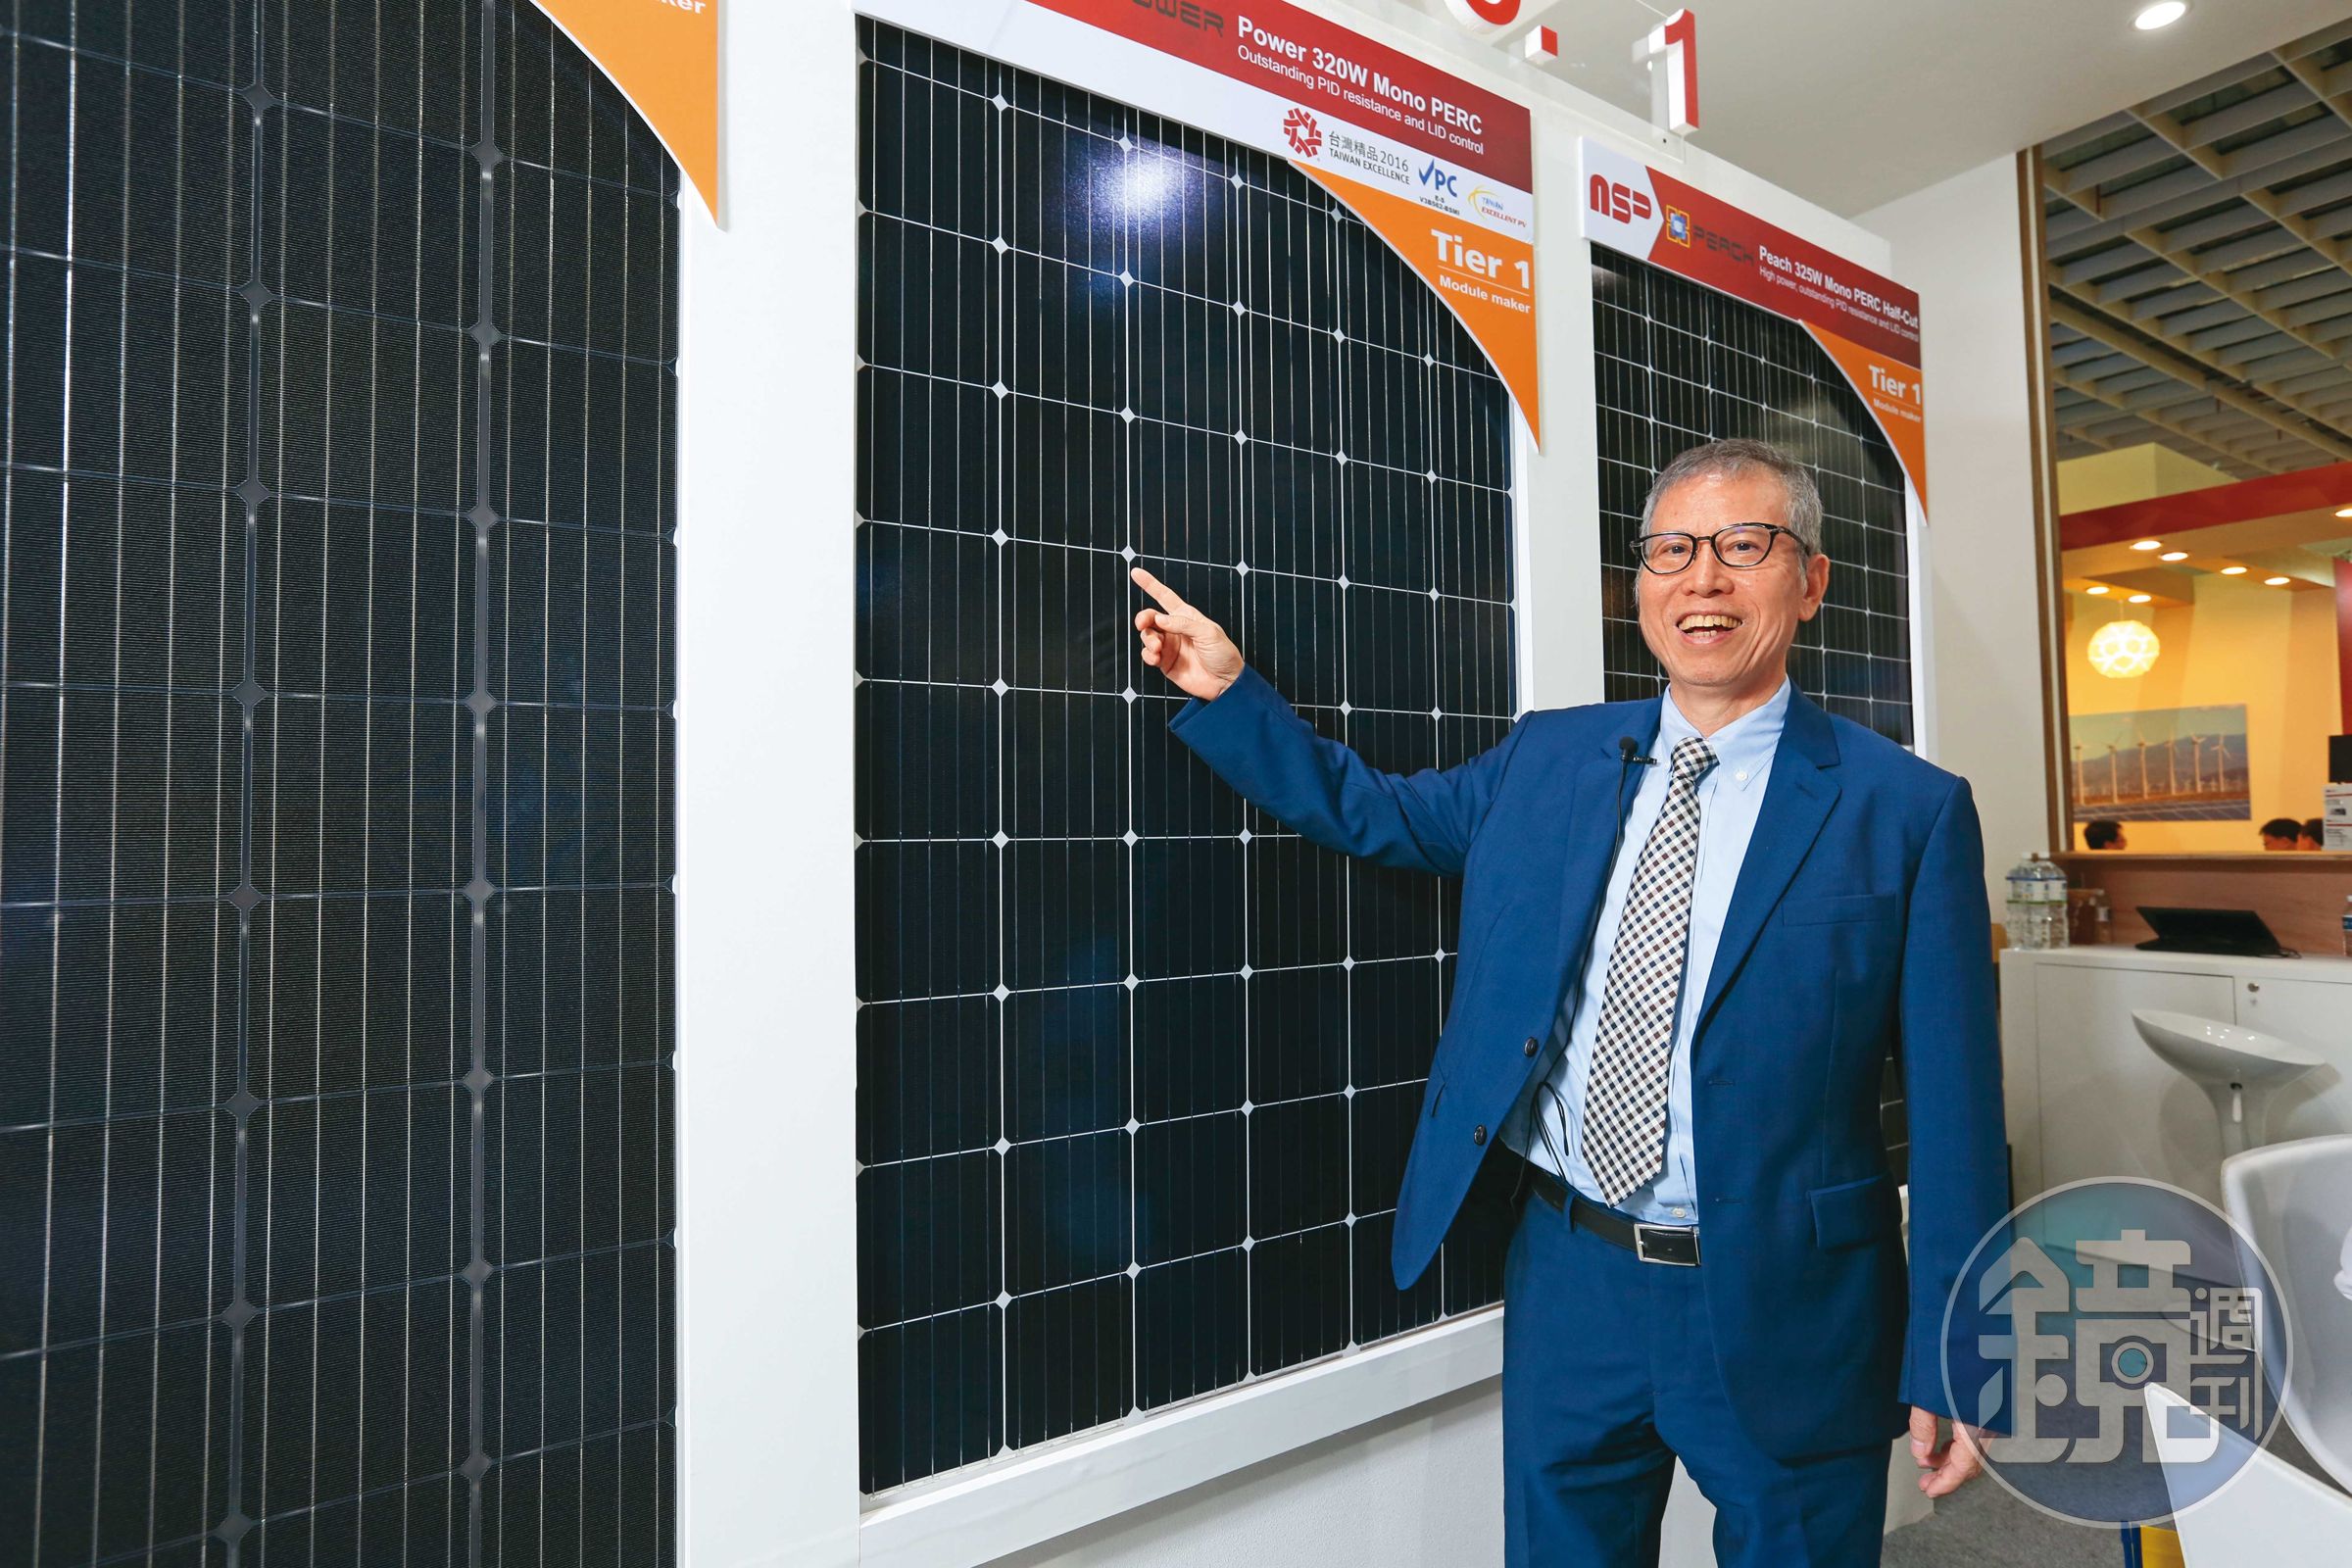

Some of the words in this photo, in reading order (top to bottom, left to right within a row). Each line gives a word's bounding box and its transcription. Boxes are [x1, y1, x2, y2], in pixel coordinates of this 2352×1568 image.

[1238, 15, 1307, 62] Power
[1312, 47, 1368, 88] 320W
[1373, 72, 1427, 112] Mono
[1431, 96, 1483, 135] PERC
[1238, 44, 1314, 90] Outstanding
[1317, 75, 1341, 96] PID
[1343, 89, 1402, 122] resistance
[1404, 113, 1425, 131] and
[1427, 121, 1447, 139] LID
[1448, 132, 1484, 155] control
[1329, 148, 1361, 167] TAIWAN
[1362, 160, 1410, 185] EXCELLENCE
[1481, 207, 1517, 224] EXCELLENT
[1431, 228, 1503, 278] Tier
[1513, 260, 1530, 290] 1
[1759, 266, 1775, 282] High
[1440, 274, 1489, 301] Module
[1491, 293, 1531, 314] maker
[1759, 245, 1792, 273] Peach
[1794, 262, 1823, 286] 325W
[1825, 274, 1851, 300] Mono
[1853, 287, 1881, 312] PERC
[1883, 300, 1919, 329] Half-Cut
[1868, 364, 1906, 399] Tier
[1911, 383, 1921, 405] 1
